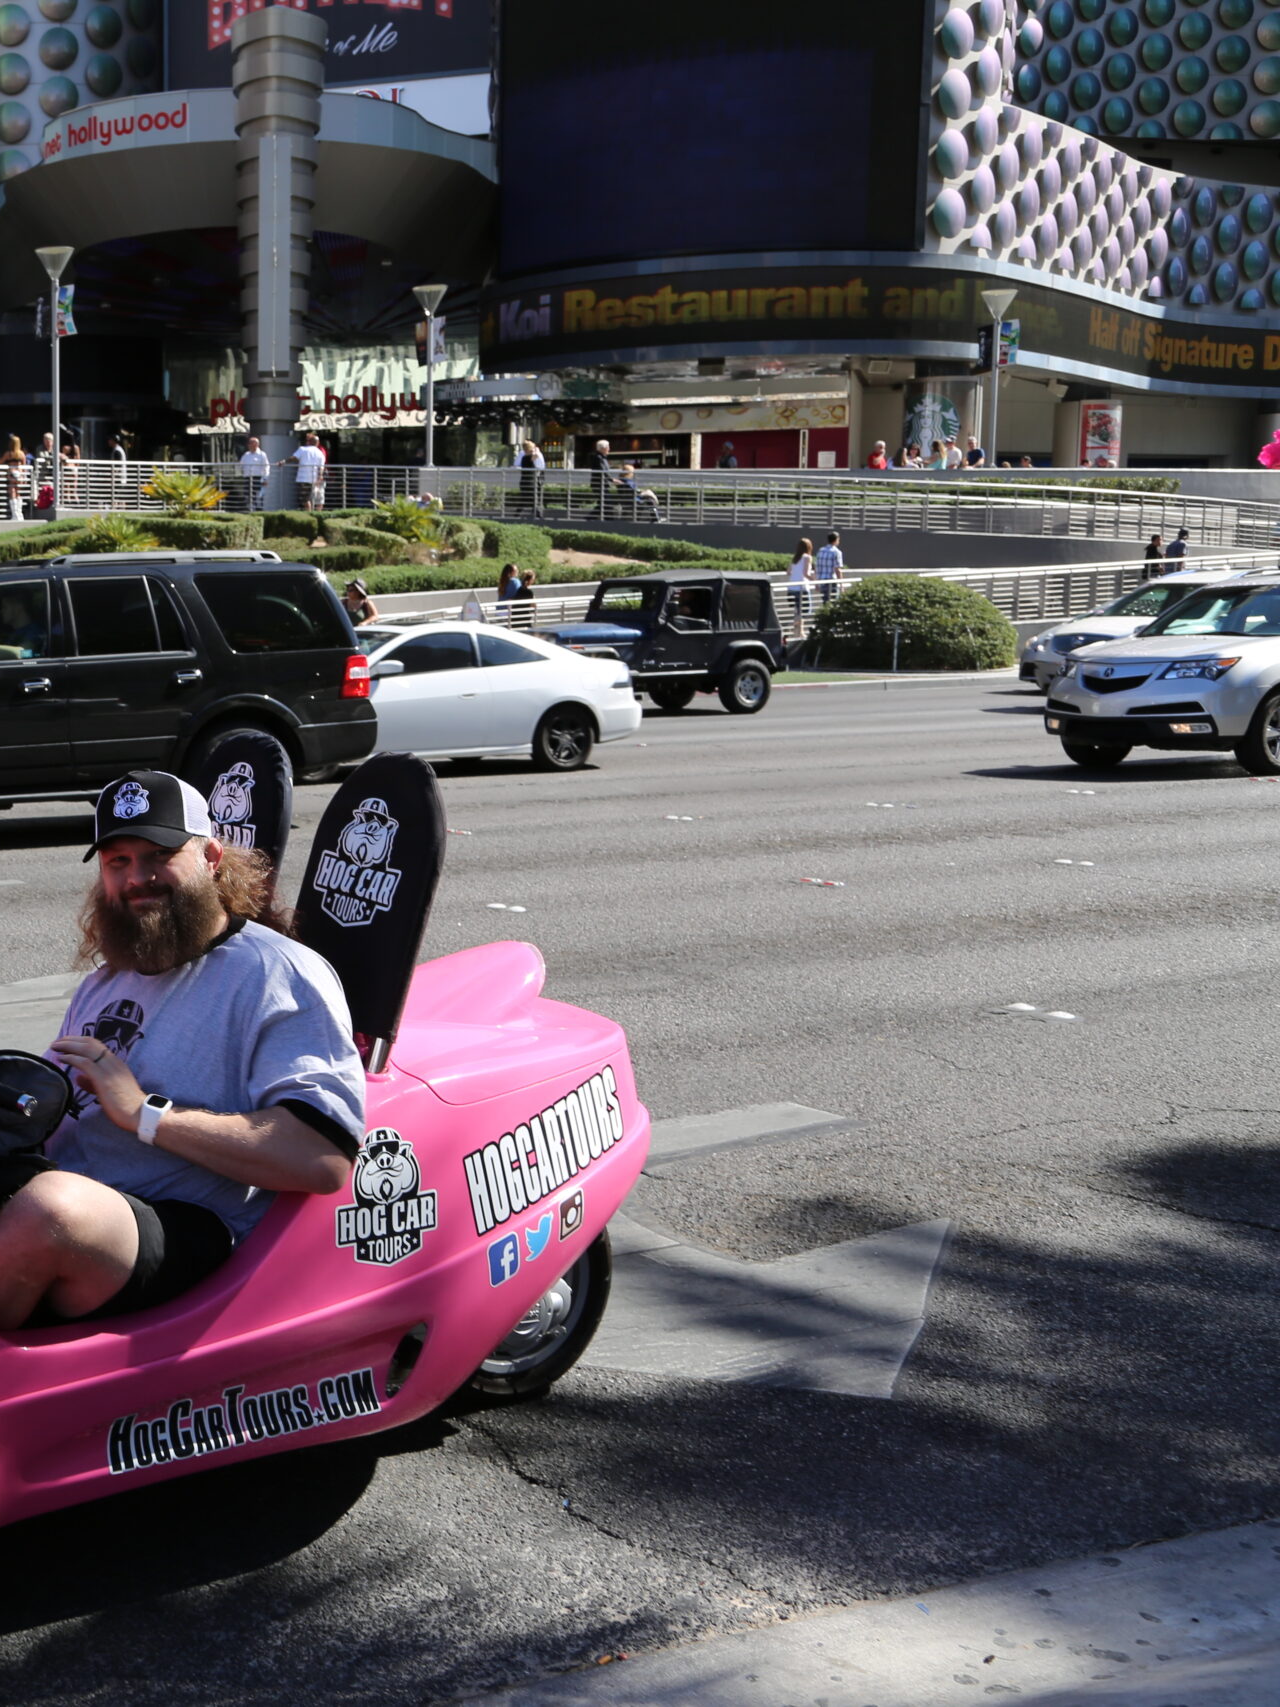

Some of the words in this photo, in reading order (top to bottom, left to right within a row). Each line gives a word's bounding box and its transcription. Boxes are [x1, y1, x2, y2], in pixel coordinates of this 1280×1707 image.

[353, 21, 399, 56] Me
[67, 102, 188, 147] hollywood
[499, 293, 552, 344] Koi
[562, 278, 869, 334] Restaurant
[883, 277, 966, 321] and
[1088, 305, 1120, 352] Half
[1121, 318, 1141, 358] off
[1143, 321, 1255, 373] Signature
[316, 855, 358, 895] HOG
[354, 867, 398, 906] CAR
[330, 892, 367, 922] TOURS
[463, 1064, 624, 1238] HOGCARTOURS
[339, 1206, 388, 1244] HOG
[391, 1196, 436, 1231] CAR
[366, 1233, 412, 1263] TOURS
